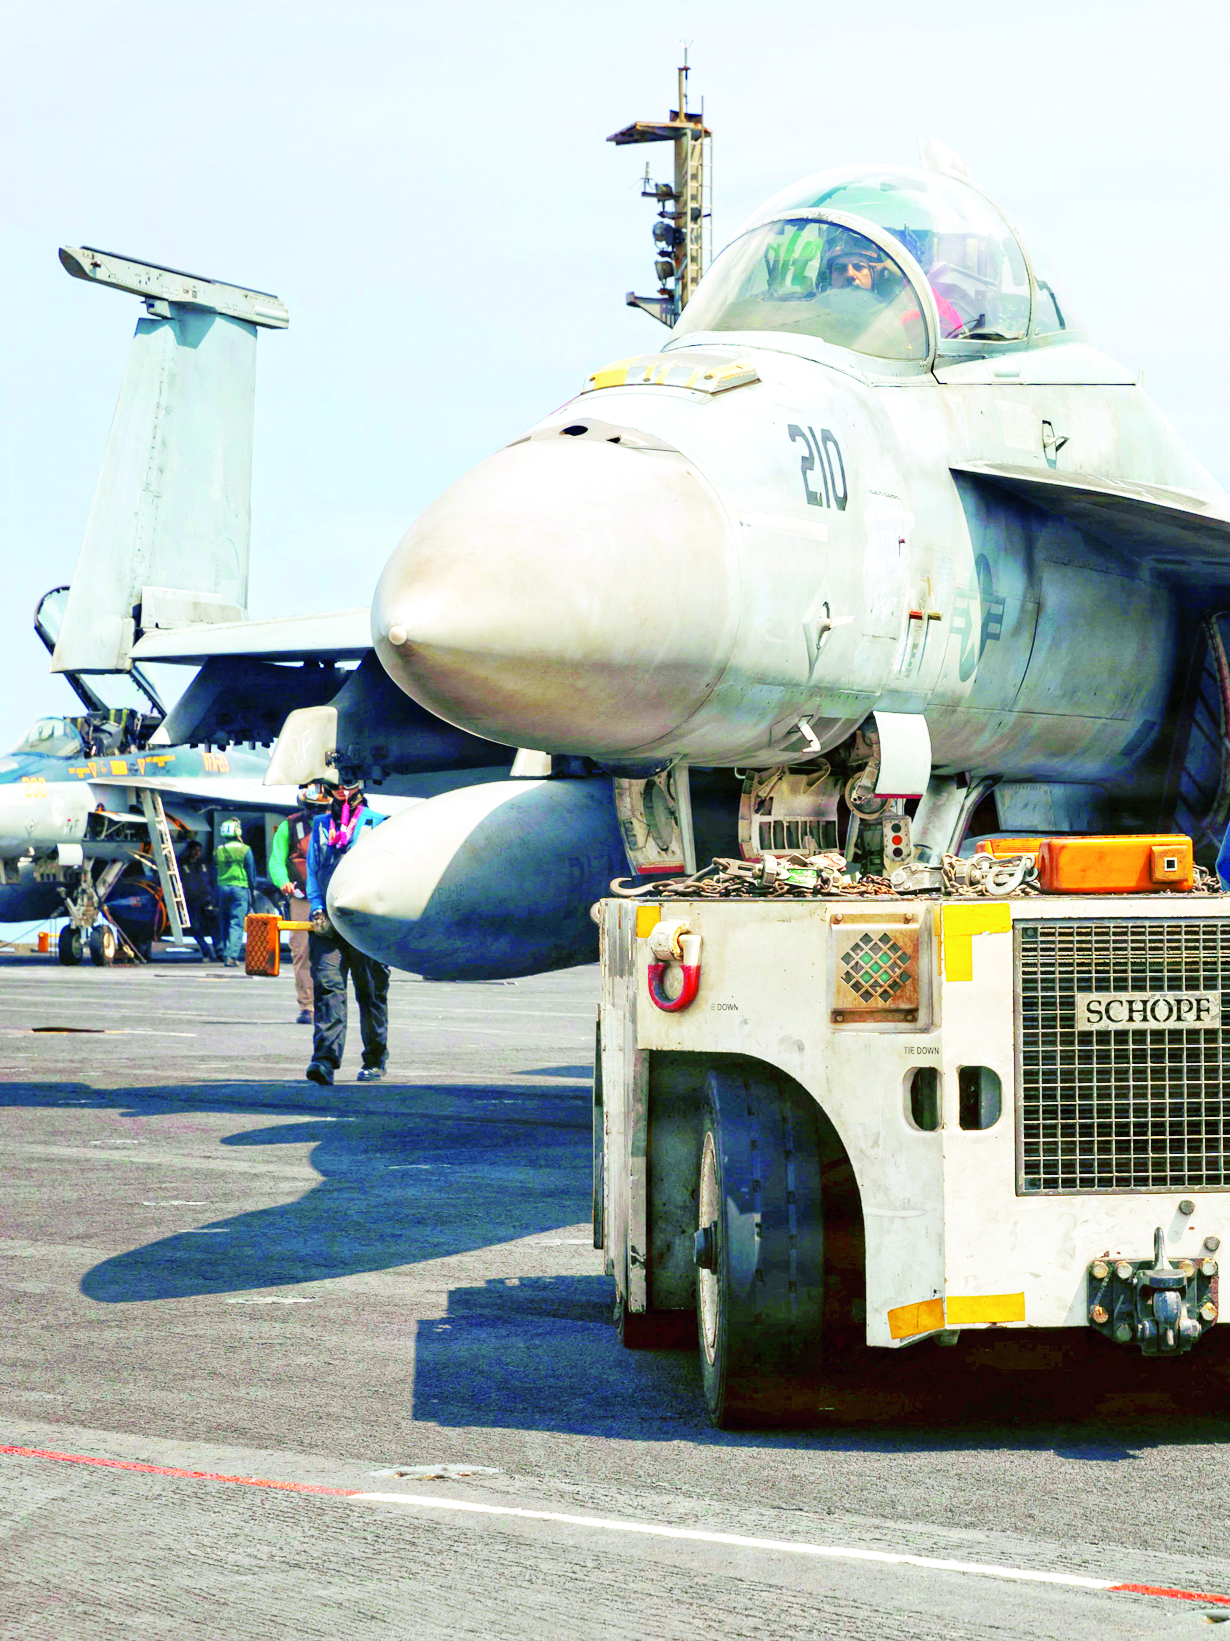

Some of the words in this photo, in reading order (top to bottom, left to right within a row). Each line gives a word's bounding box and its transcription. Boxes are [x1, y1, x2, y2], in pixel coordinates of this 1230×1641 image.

[787, 424, 848, 511] 210
[717, 1003, 739, 1011] DOWN
[1086, 998, 1210, 1024] SCHOPF
[903, 1046, 915, 1055] TIE
[916, 1046, 940, 1055] DOWN
